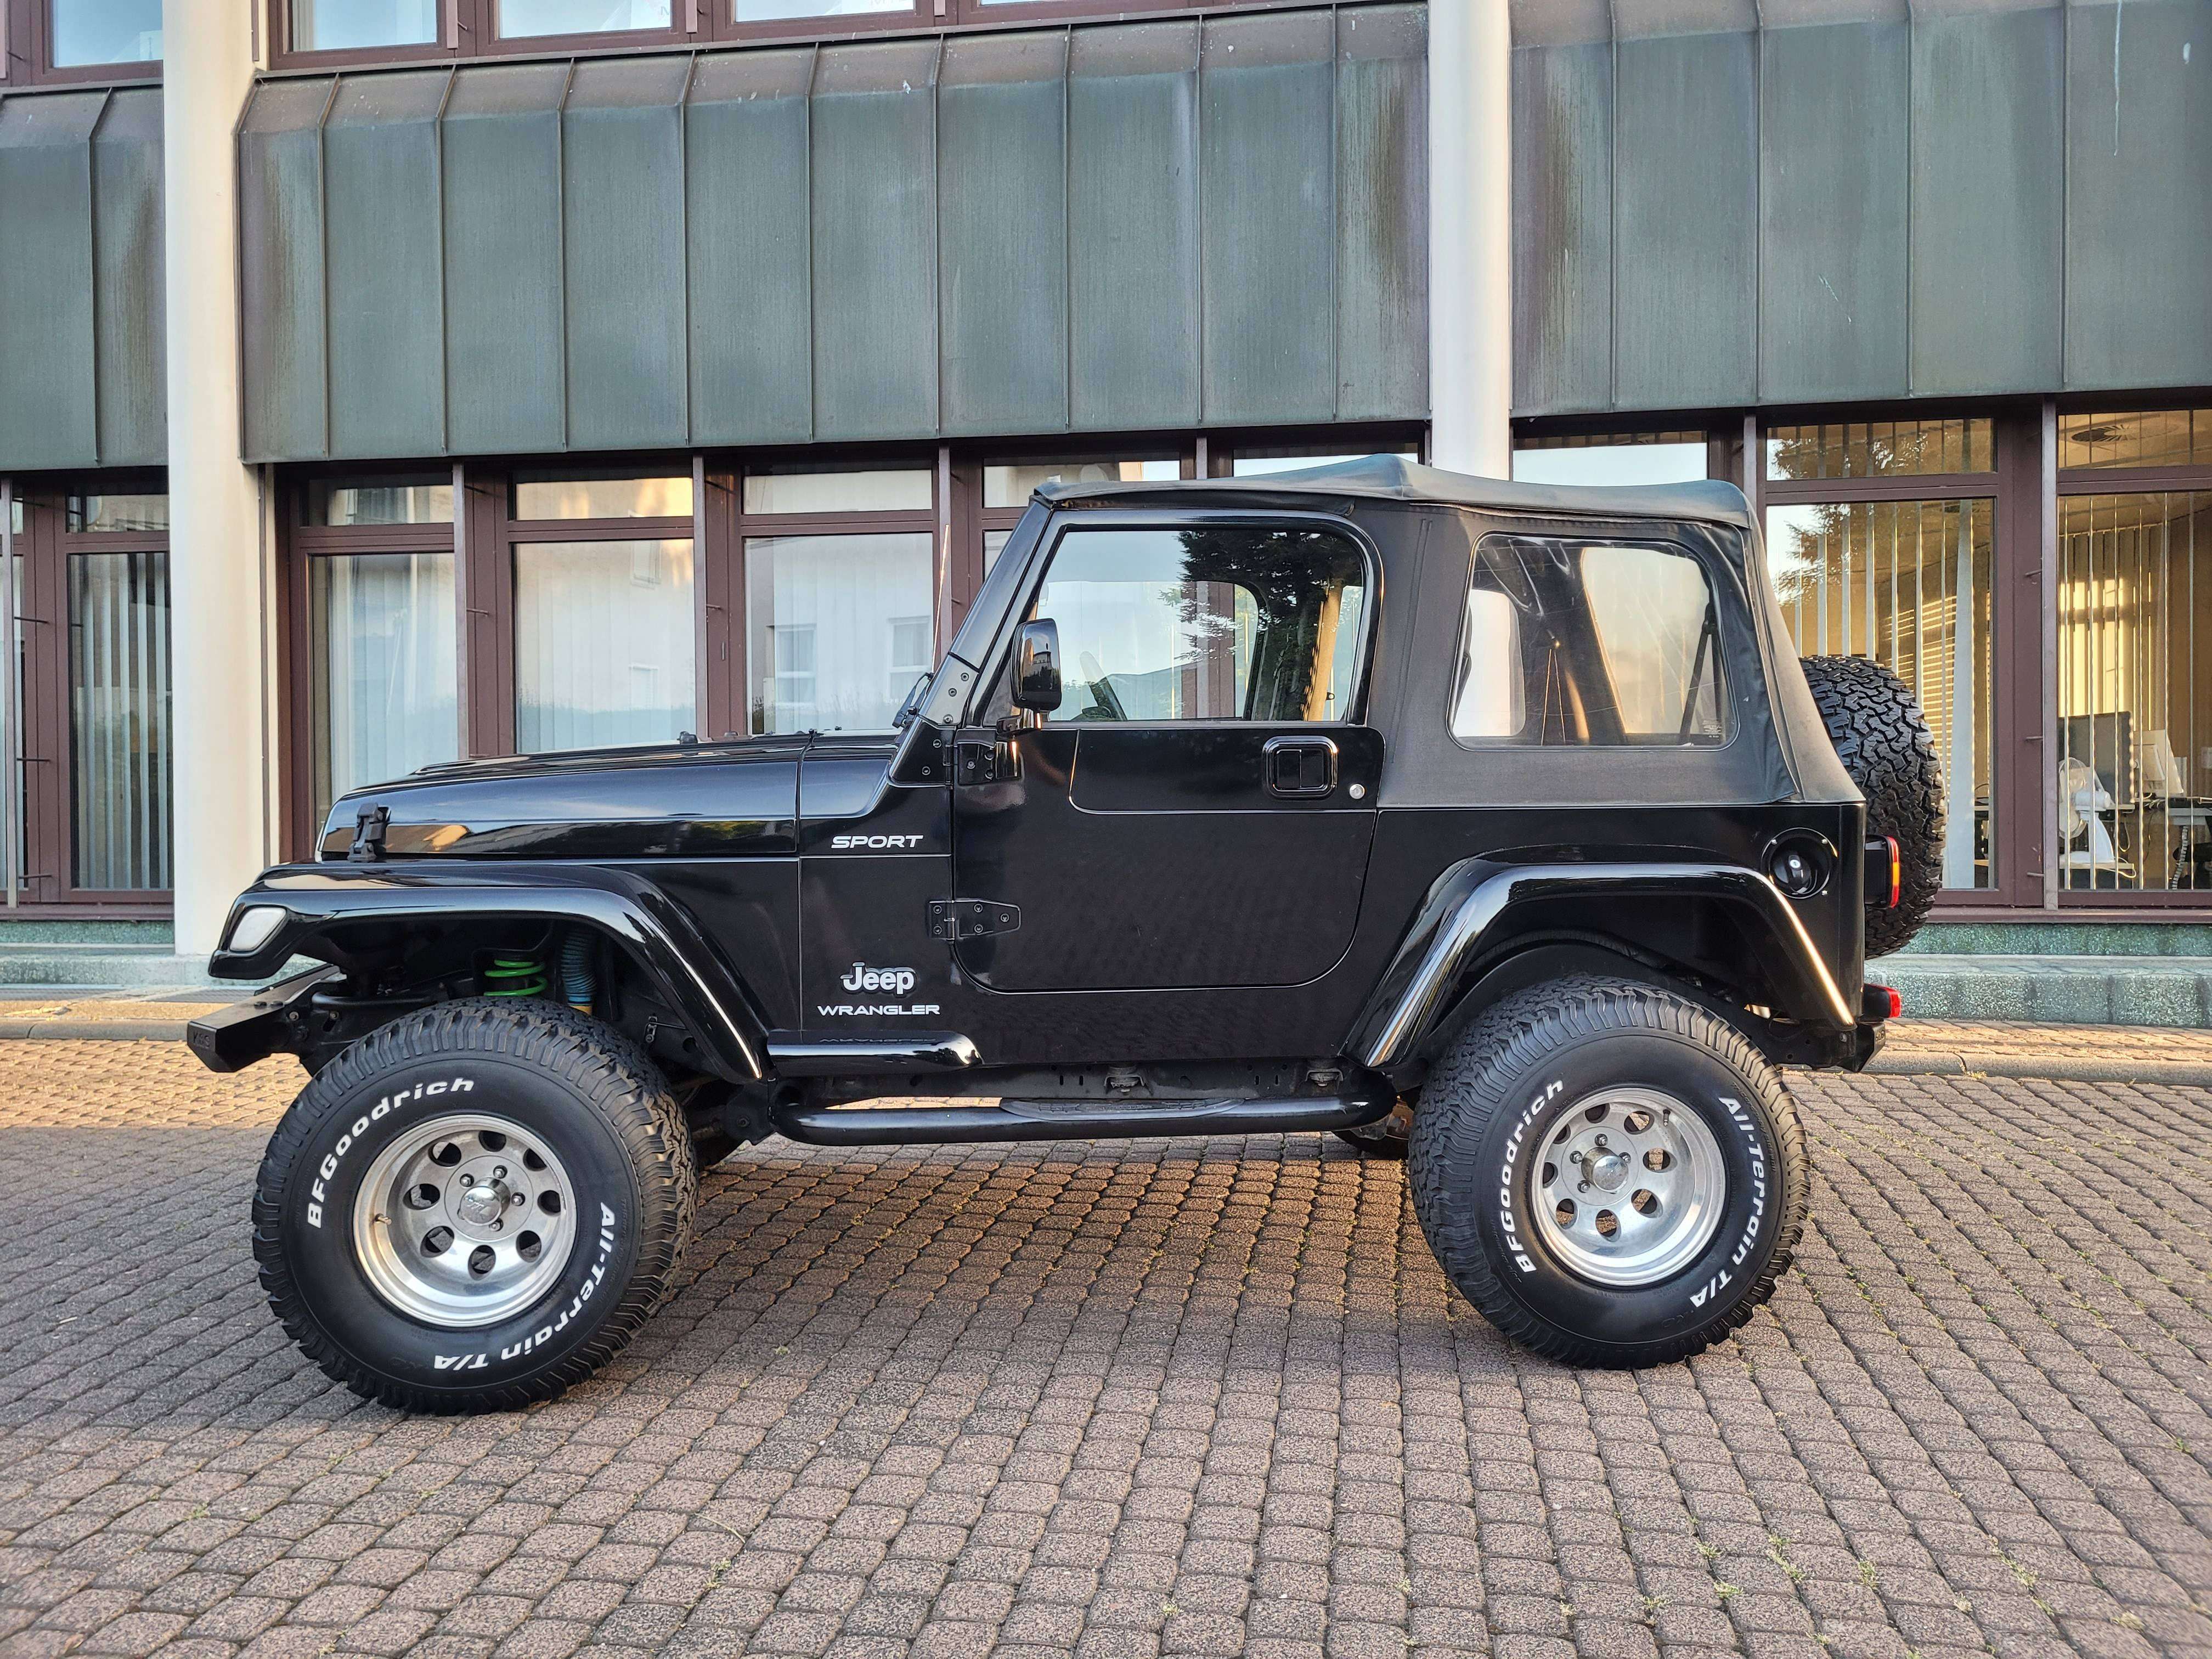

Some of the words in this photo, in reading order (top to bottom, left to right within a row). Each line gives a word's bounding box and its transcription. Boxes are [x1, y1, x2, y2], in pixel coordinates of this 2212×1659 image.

[831, 835, 924, 849] SPORT
[841, 963, 915, 995] Jeep
[817, 1005, 940, 1016] WRANGLER
[307, 1078, 475, 1228] BFGoodrich
[1500, 1080, 1564, 1273] BFGoodrich
[1718, 1097, 1765, 1265] All-Terrain
[501, 1202, 615, 1360] All-Terrain
[1689, 1269, 1733, 1308] T/A
[433, 1353, 489, 1371] T/A
